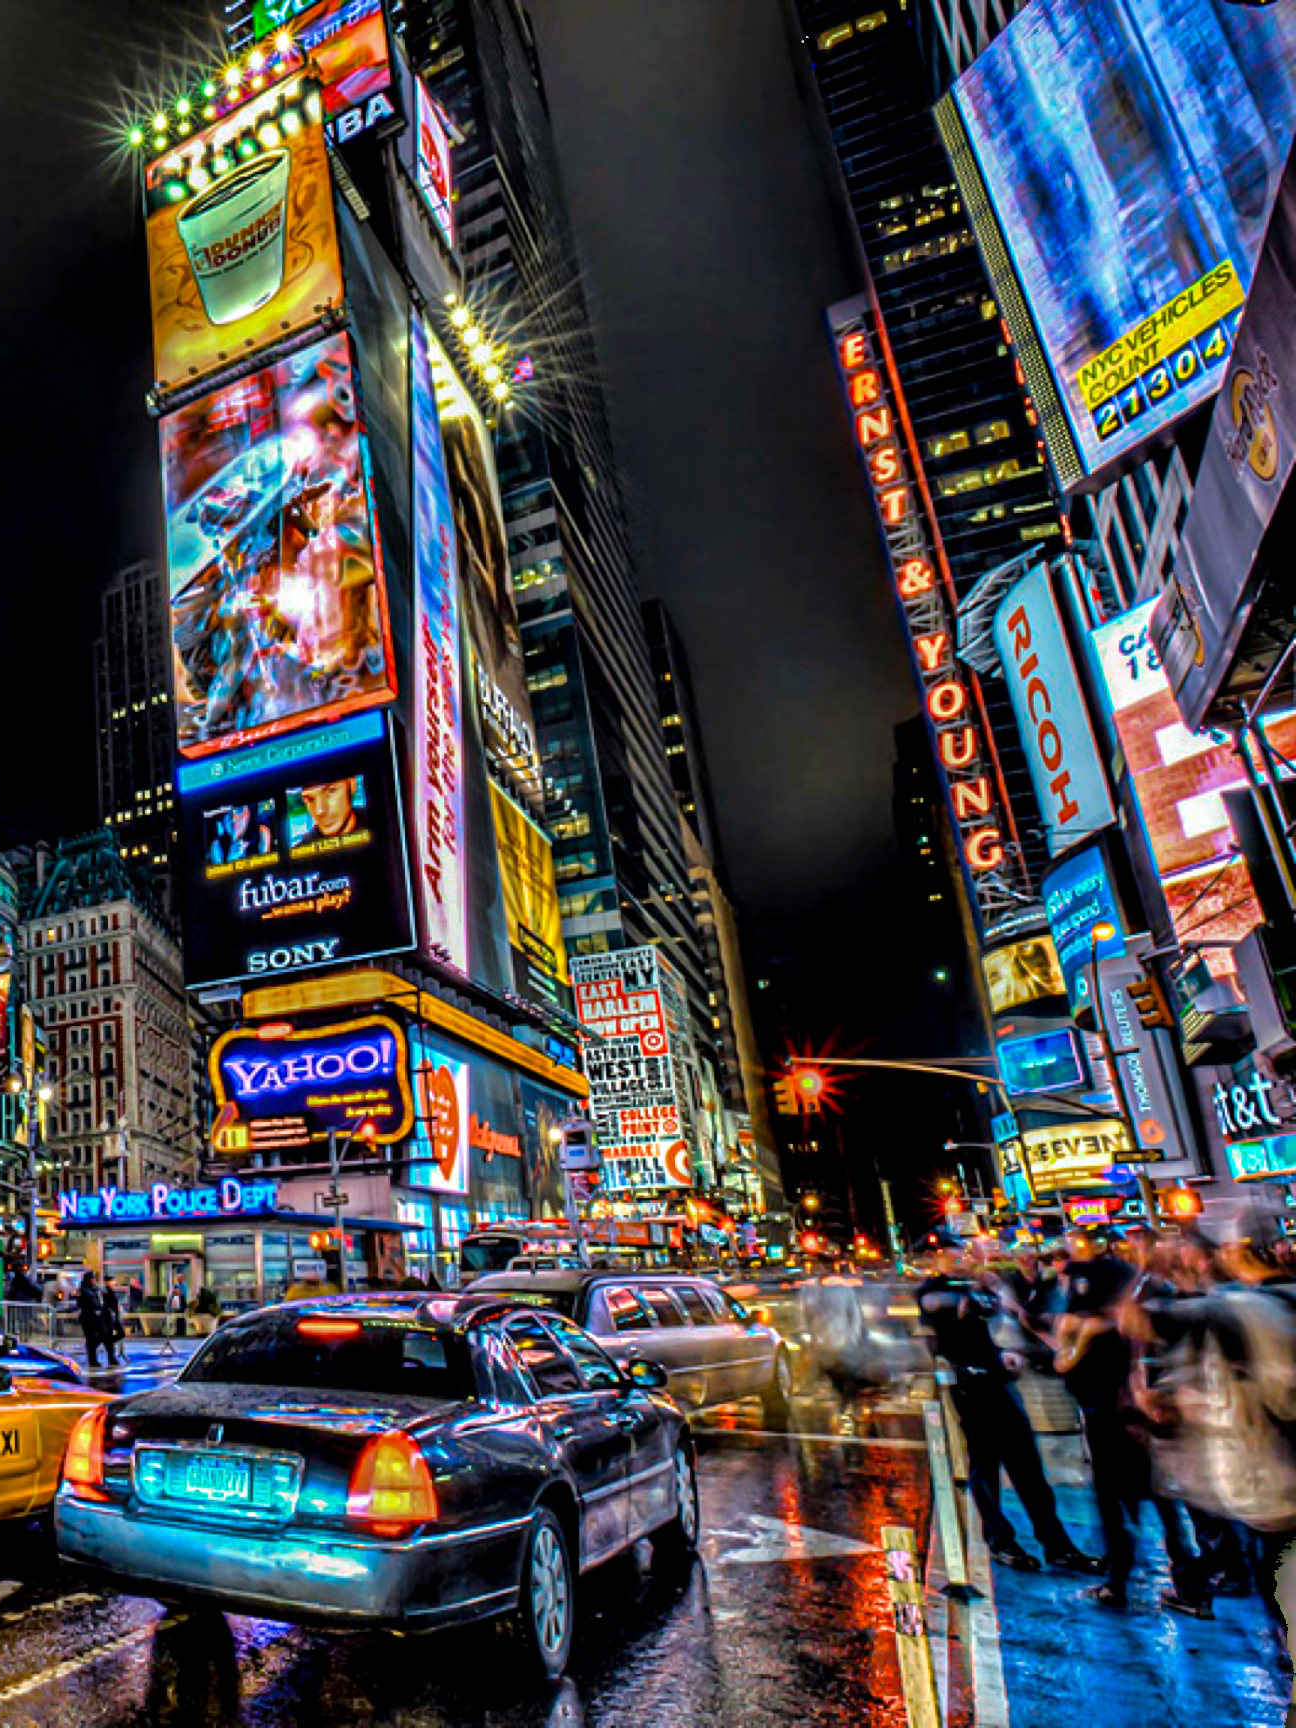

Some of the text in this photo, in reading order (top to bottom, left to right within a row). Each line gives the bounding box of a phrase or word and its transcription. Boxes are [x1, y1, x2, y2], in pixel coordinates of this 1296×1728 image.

[324, 92, 395, 148] BA
[1082, 264, 1233, 386] NYC VEHICLES
[1089, 339, 1162, 403] COUNT
[839, 332, 907, 524] ERNST
[914, 632, 1004, 870] YOUNG
[1007, 605, 1079, 825] RICOH
[421, 611, 444, 904] Arm yourself
[247, 937, 340, 972] SONY
[580, 981, 618, 1000] EAST
[581, 994, 657, 1019] HARLEM
[223, 1038, 392, 1096] YAHOO!
[587, 1059, 642, 1081] WEST
[100, 1186, 151, 1217] YORK
[152, 1182, 218, 1214] POLICE
[221, 1178, 277, 1212] DEPT
